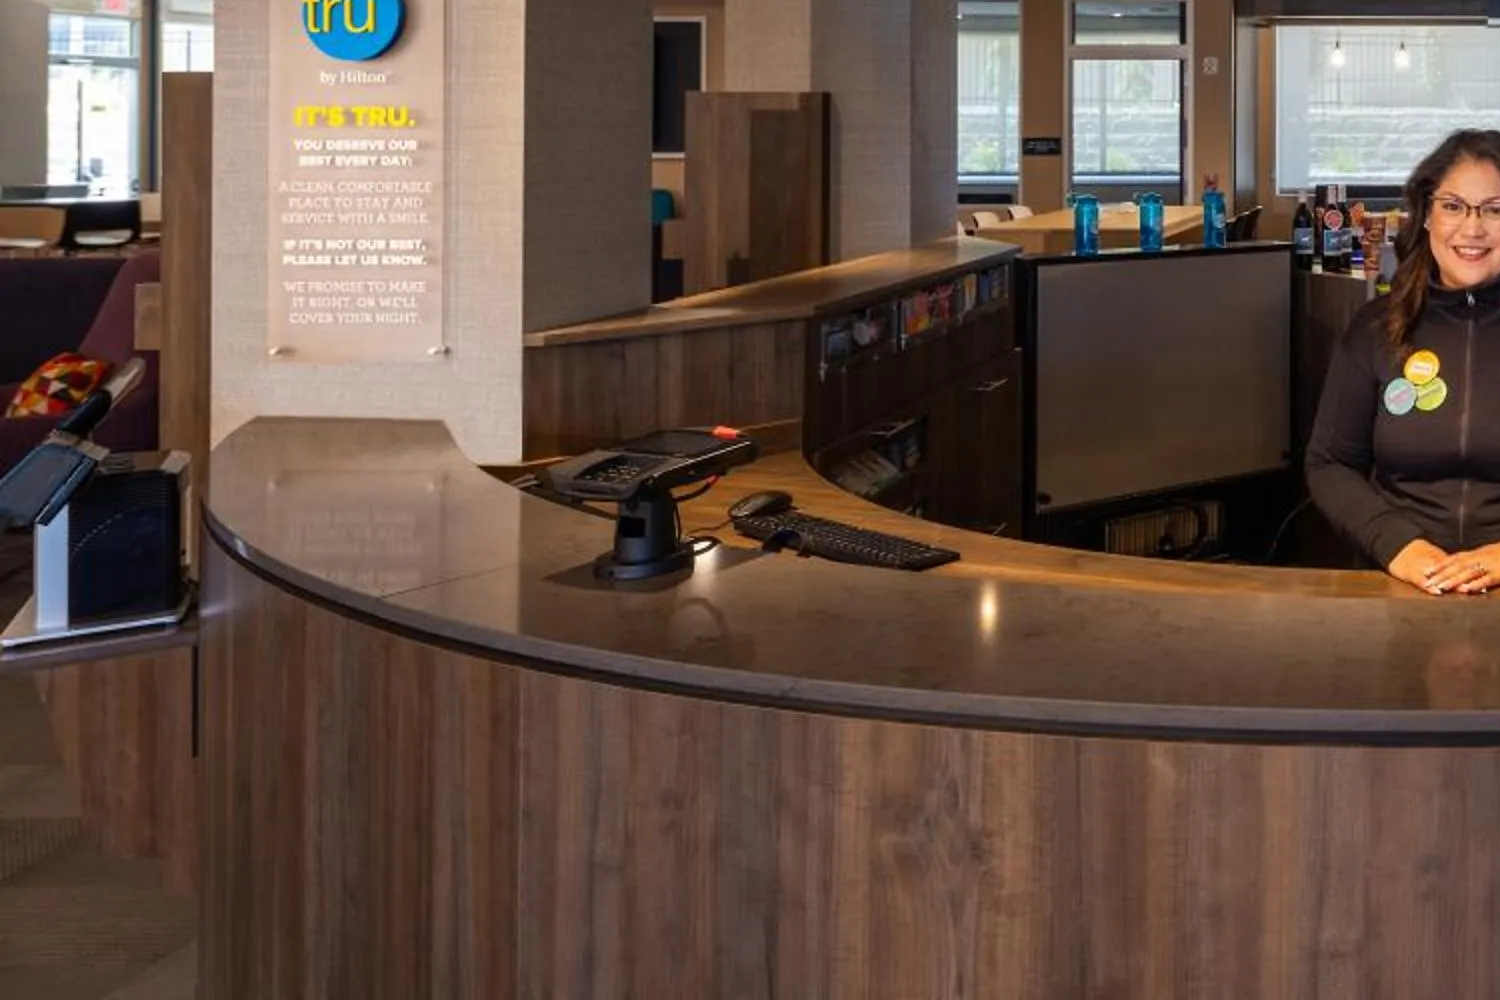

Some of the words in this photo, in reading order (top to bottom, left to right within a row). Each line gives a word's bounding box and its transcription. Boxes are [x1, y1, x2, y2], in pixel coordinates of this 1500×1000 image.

[319, 70, 338, 87] by
[293, 104, 345, 128] IT'S
[351, 104, 416, 129] TRU.
[293, 139, 323, 151] YOU
[326, 139, 385, 151] DESERVE
[388, 139, 418, 151] OUR
[298, 155, 331, 167] BEST
[335, 155, 377, 167] EVERY
[278, 180, 289, 193] A
[288, 197, 329, 209] PLACE
[333, 197, 353, 209] TO
[356, 197, 390, 209] STAY
[393, 197, 423, 209] AND
[338, 212, 373, 224] WITH
[376, 212, 387, 224] A
[282, 238, 297, 250] IF
[325, 238, 354, 250] NOT
[356, 238, 386, 250] OUR
[282, 254, 331, 265] PLEASE
[334, 254, 357, 265] LET
[360, 254, 379, 265] US
[381, 254, 427, 265] KNOW.
[283, 280, 306, 293] WE
[365, 280, 386, 293] TO
[388, 280, 427, 293] MAKE
[292, 296, 305, 308] IT
[356, 296, 375, 308] OR
[289, 312, 334, 324] COVER
[337, 312, 373, 324] YOUR
